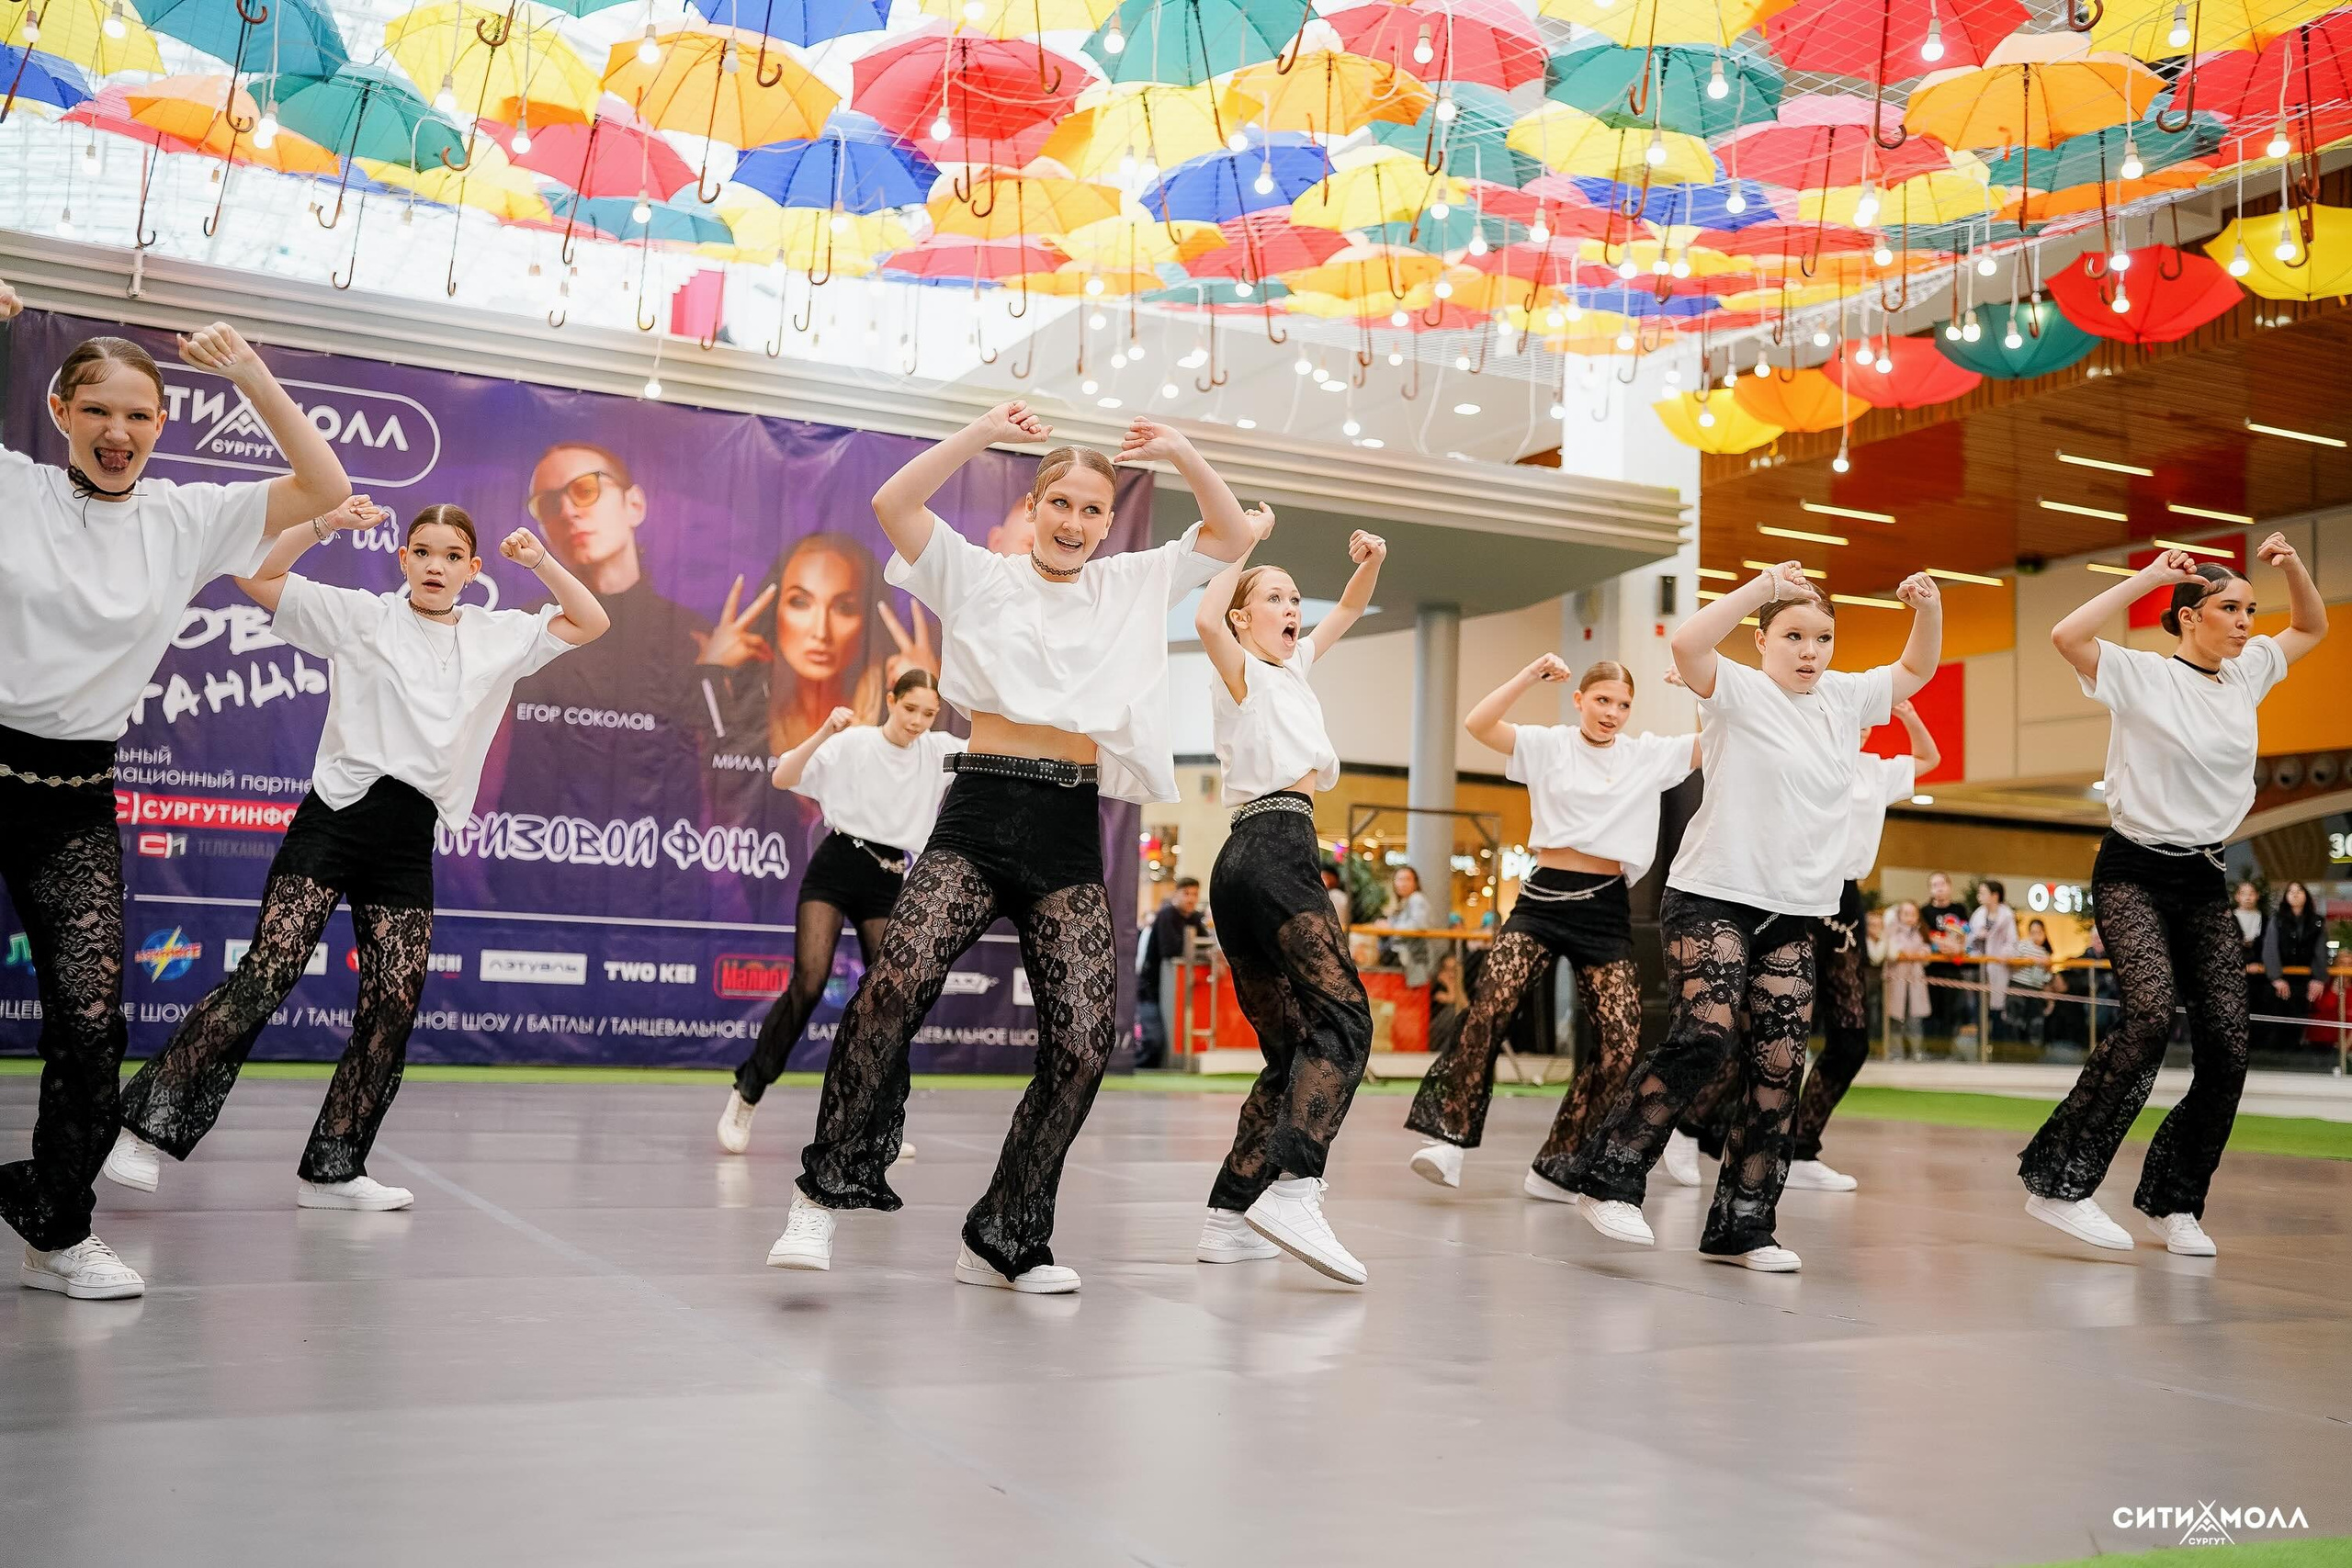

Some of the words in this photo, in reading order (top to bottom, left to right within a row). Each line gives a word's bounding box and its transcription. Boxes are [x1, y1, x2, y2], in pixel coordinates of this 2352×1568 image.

[210, 437, 275, 459] СУРГУТ
[516, 703, 561, 723] ЕГОР
[563, 706, 656, 731] СОКОЛОВ
[712, 753, 764, 773] МИЛА
[662, 818, 790, 881] ФОНД
[603, 960, 657, 983] TWO
[660, 964, 696, 984] KEI
[141, 1003, 193, 1023] ШОУ
[461, 1012, 511, 1032] ШОУ
[526, 1014, 594, 1035] БАТТЛЫ
[611, 1017, 748, 1040] ТАНЦЕВАЛЬНОЕ
